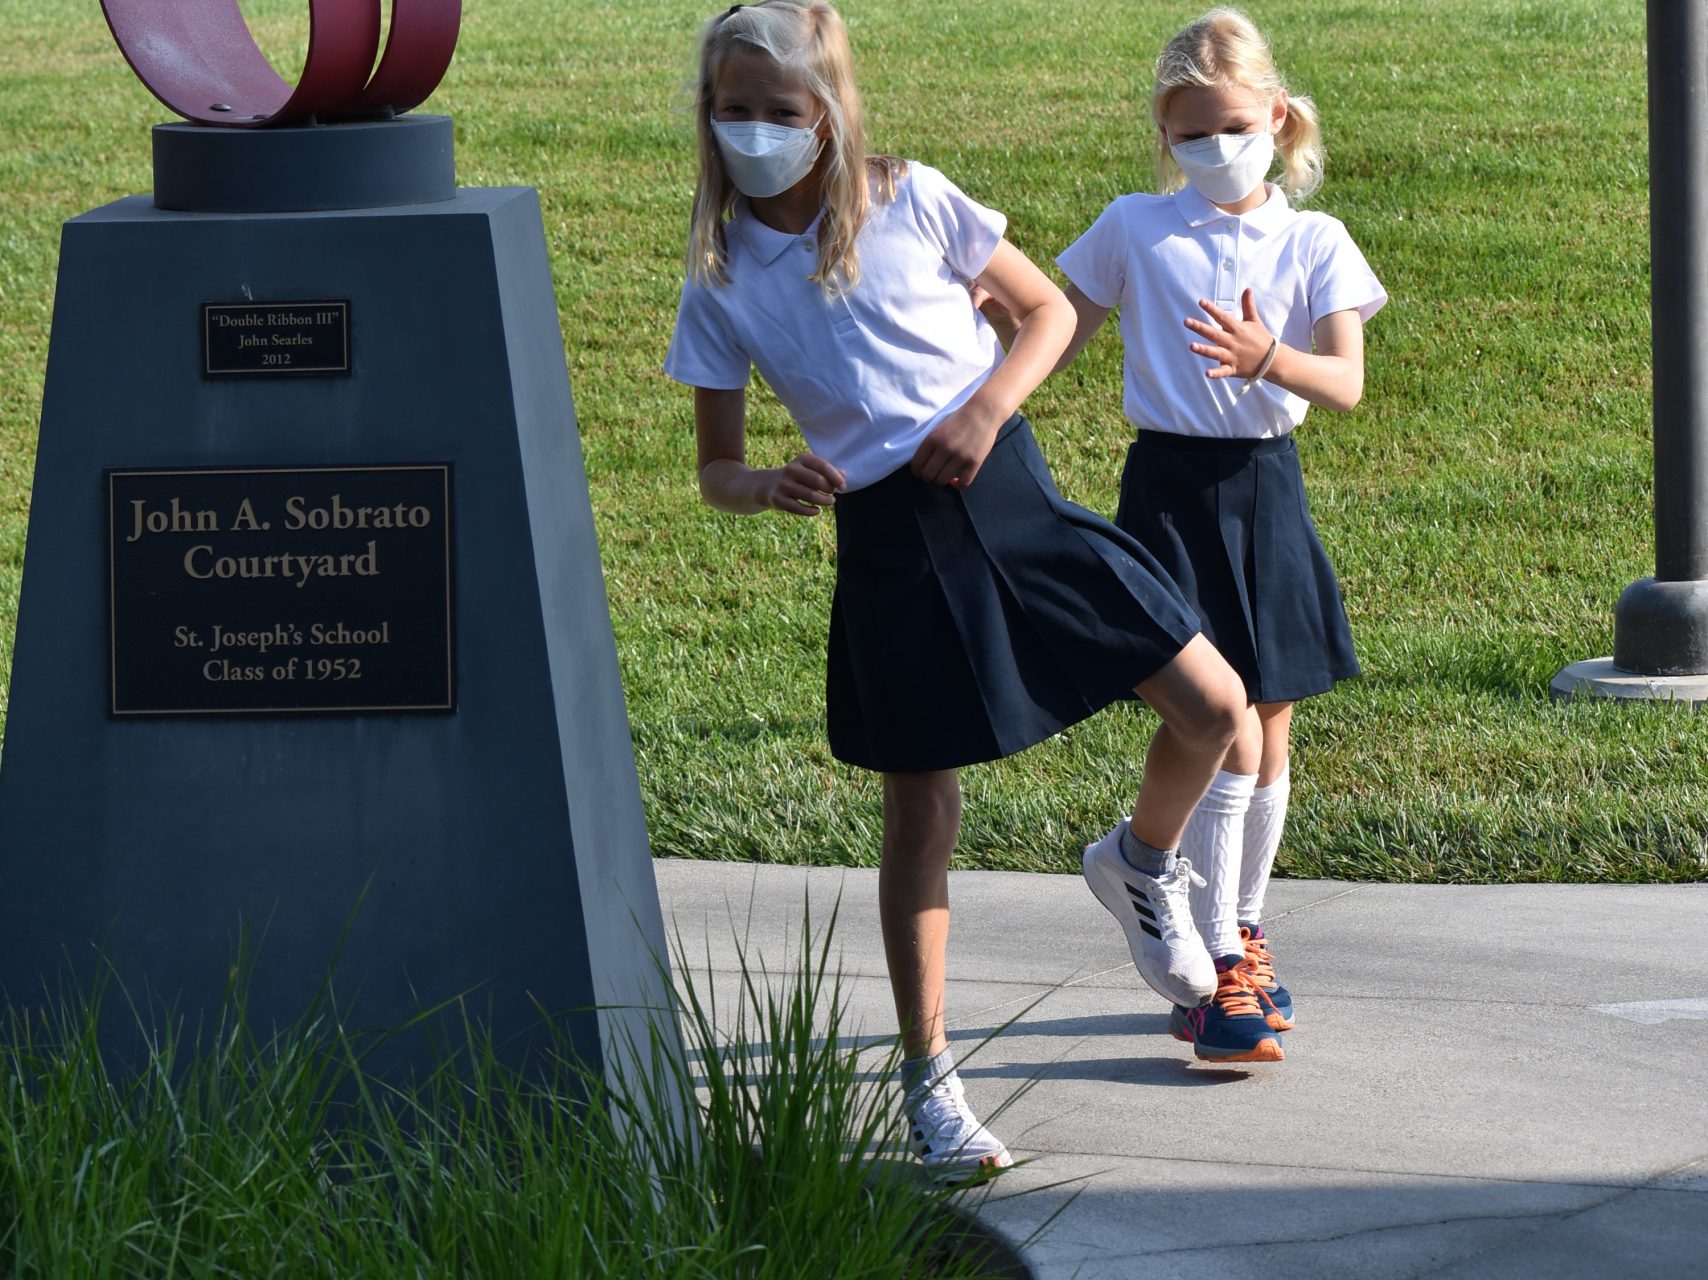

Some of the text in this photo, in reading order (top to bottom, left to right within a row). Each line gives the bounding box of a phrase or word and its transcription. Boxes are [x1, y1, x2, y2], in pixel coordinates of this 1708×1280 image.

[268, 313, 312, 326] Ribbon
[238, 333, 313, 349] John Searles
[261, 354, 291, 365] 2012
[127, 494, 431, 542] John A. Sobrato
[183, 540, 380, 588] Courtyard
[174, 625, 204, 648] St.
[310, 621, 390, 646] School
[203, 658, 362, 682] Class of 1952
